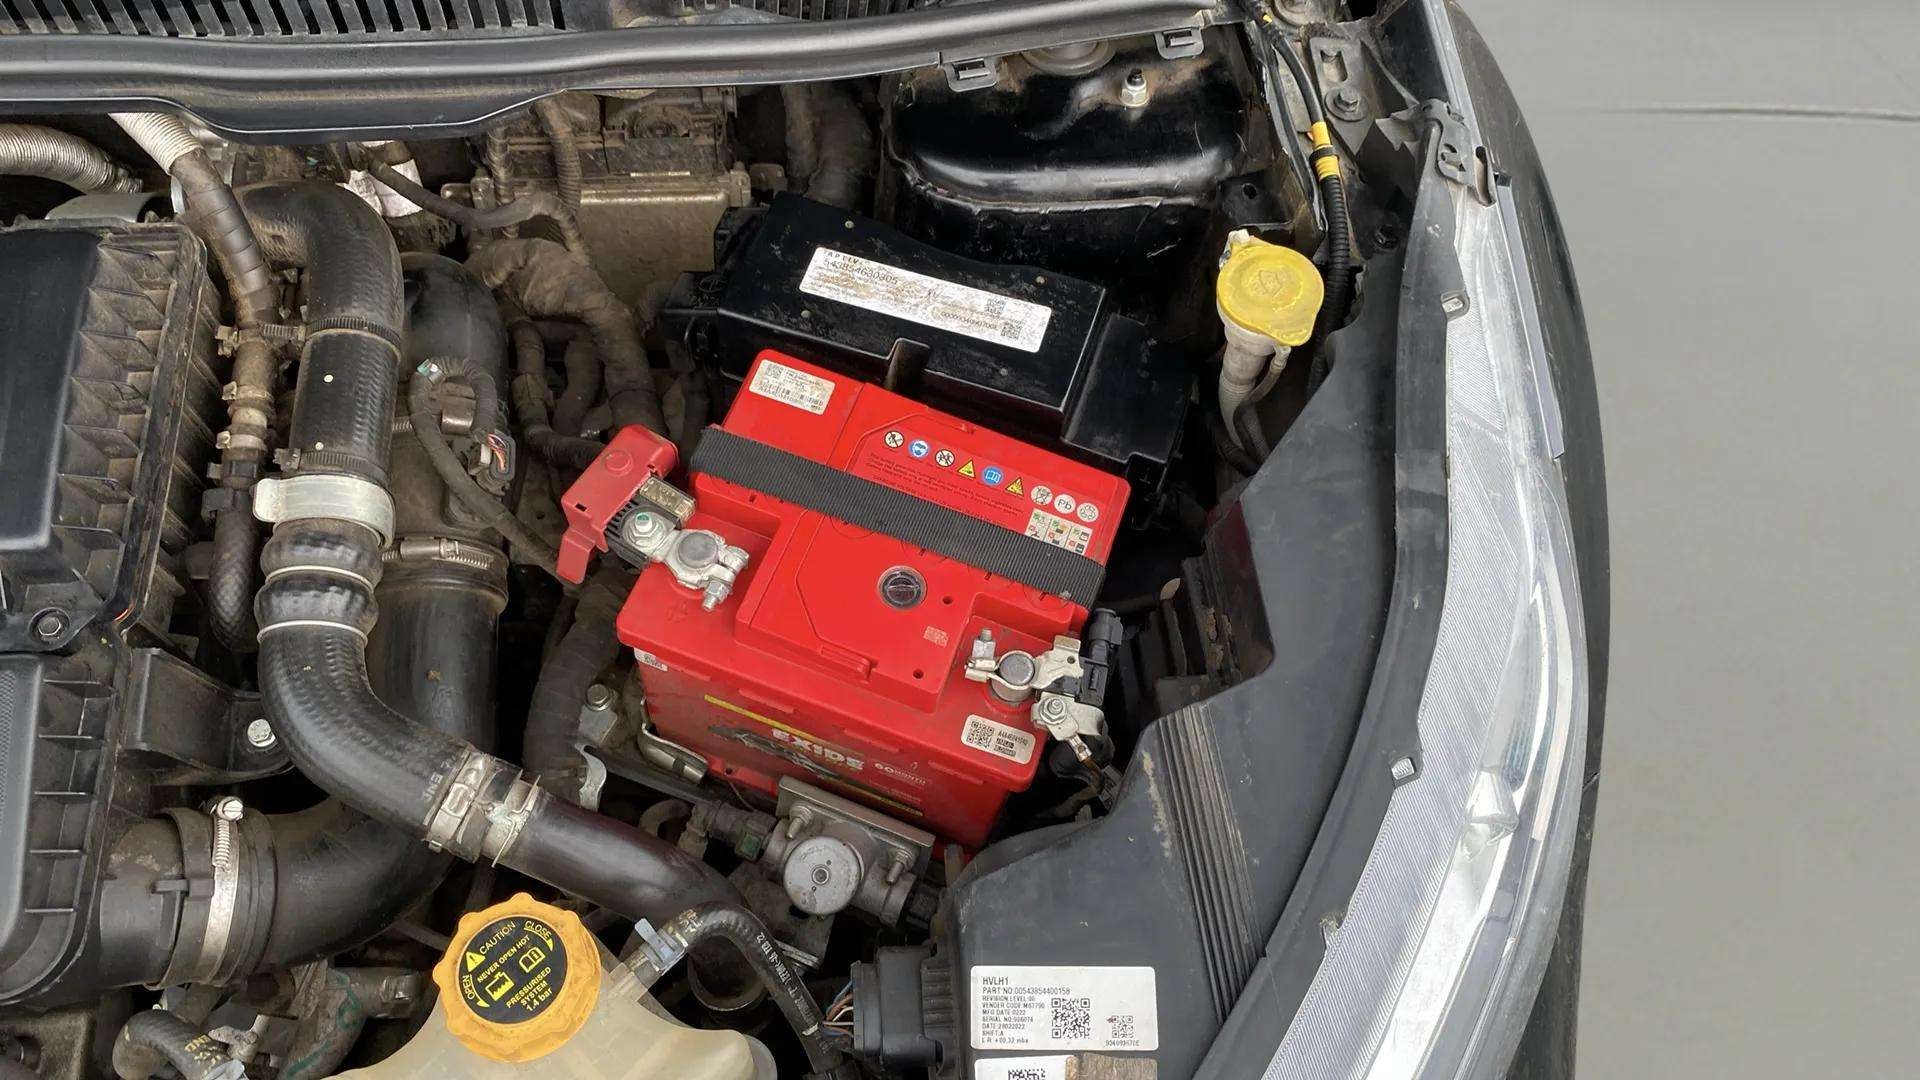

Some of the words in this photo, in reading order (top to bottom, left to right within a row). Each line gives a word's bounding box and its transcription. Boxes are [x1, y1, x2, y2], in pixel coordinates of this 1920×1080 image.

[1057, 498, 1073, 511] Pb
[771, 728, 865, 770] EXIDE
[480, 921, 516, 954] CAUTION
[525, 920, 552, 939] CLOSE
[477, 962, 500, 983] NEVER
[498, 946, 517, 964] OPEN
[516, 935, 531, 950] HOT
[462, 974, 476, 1000] OPEN
[505, 966, 552, 1008] PRESSURISED
[520, 980, 549, 1006] SYSTEM
[982, 977, 1009, 986] HVLH1
[982, 987, 1001, 995] PART
[526, 999, 540, 1012] 1.4
[537, 987, 553, 1002] bar
